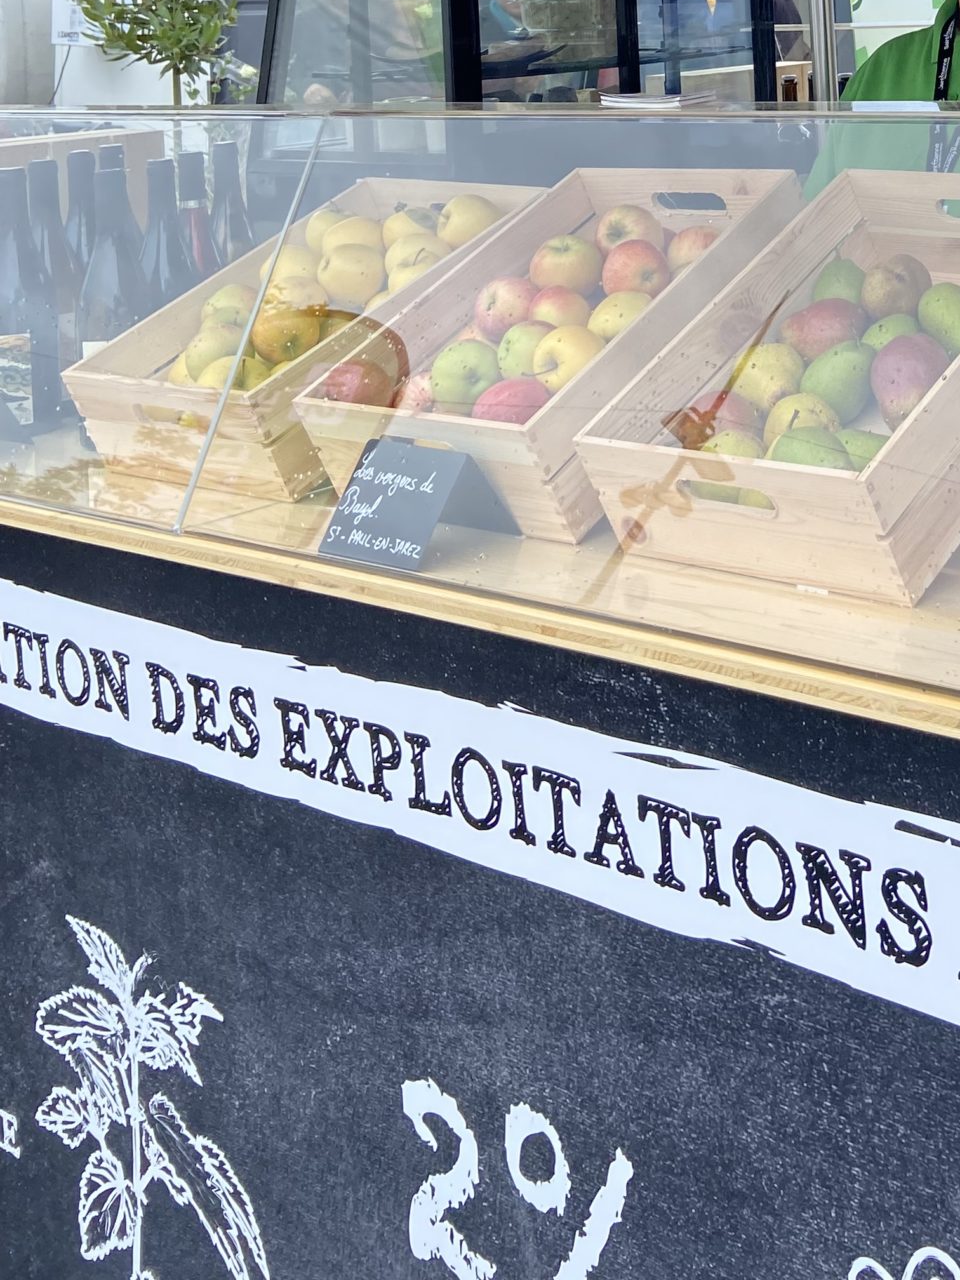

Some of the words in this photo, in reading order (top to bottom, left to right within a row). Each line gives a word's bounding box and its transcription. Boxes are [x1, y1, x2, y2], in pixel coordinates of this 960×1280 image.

[354, 448, 376, 479] Les
[375, 471, 417, 496] vergers
[419, 471, 436, 494] de
[0, 624, 130, 720] TION
[145, 661, 261, 759] DES
[273, 697, 933, 969] EXPLOITATIONS
